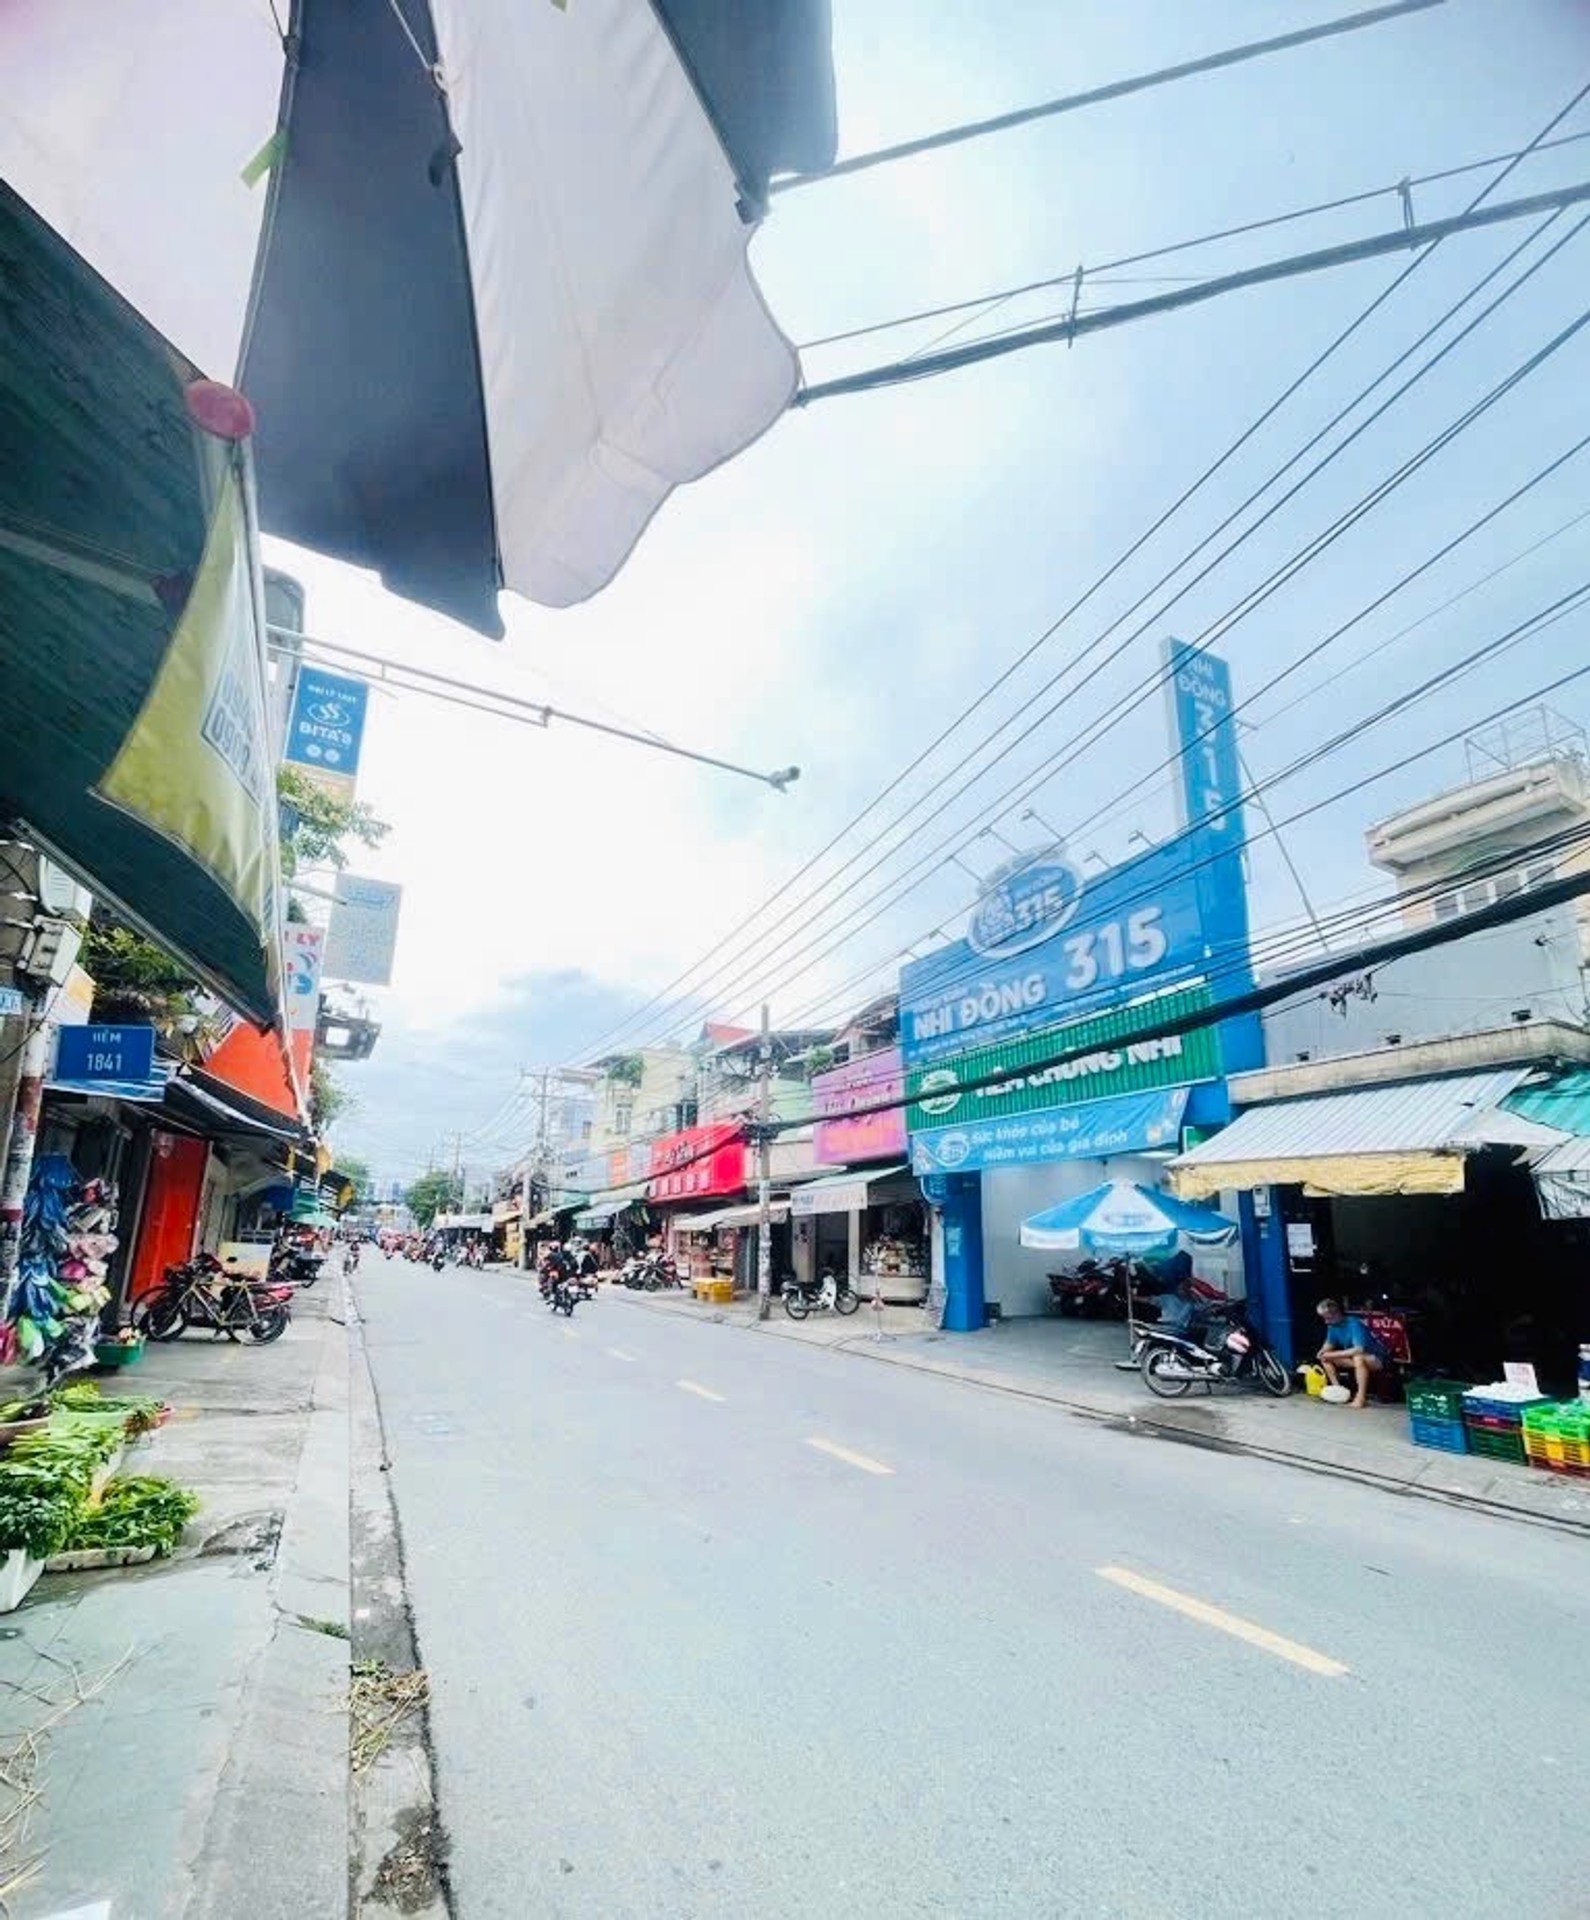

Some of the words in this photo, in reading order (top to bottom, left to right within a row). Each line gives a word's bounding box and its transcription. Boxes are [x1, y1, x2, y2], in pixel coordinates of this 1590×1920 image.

[914, 1007, 952, 1041] NHI
[958, 973, 1047, 1027] ĐỒNG
[1065, 907, 1168, 989] 315
[86, 1053, 122, 1071] 1841
[1127, 1035, 1183, 1066] NHI
